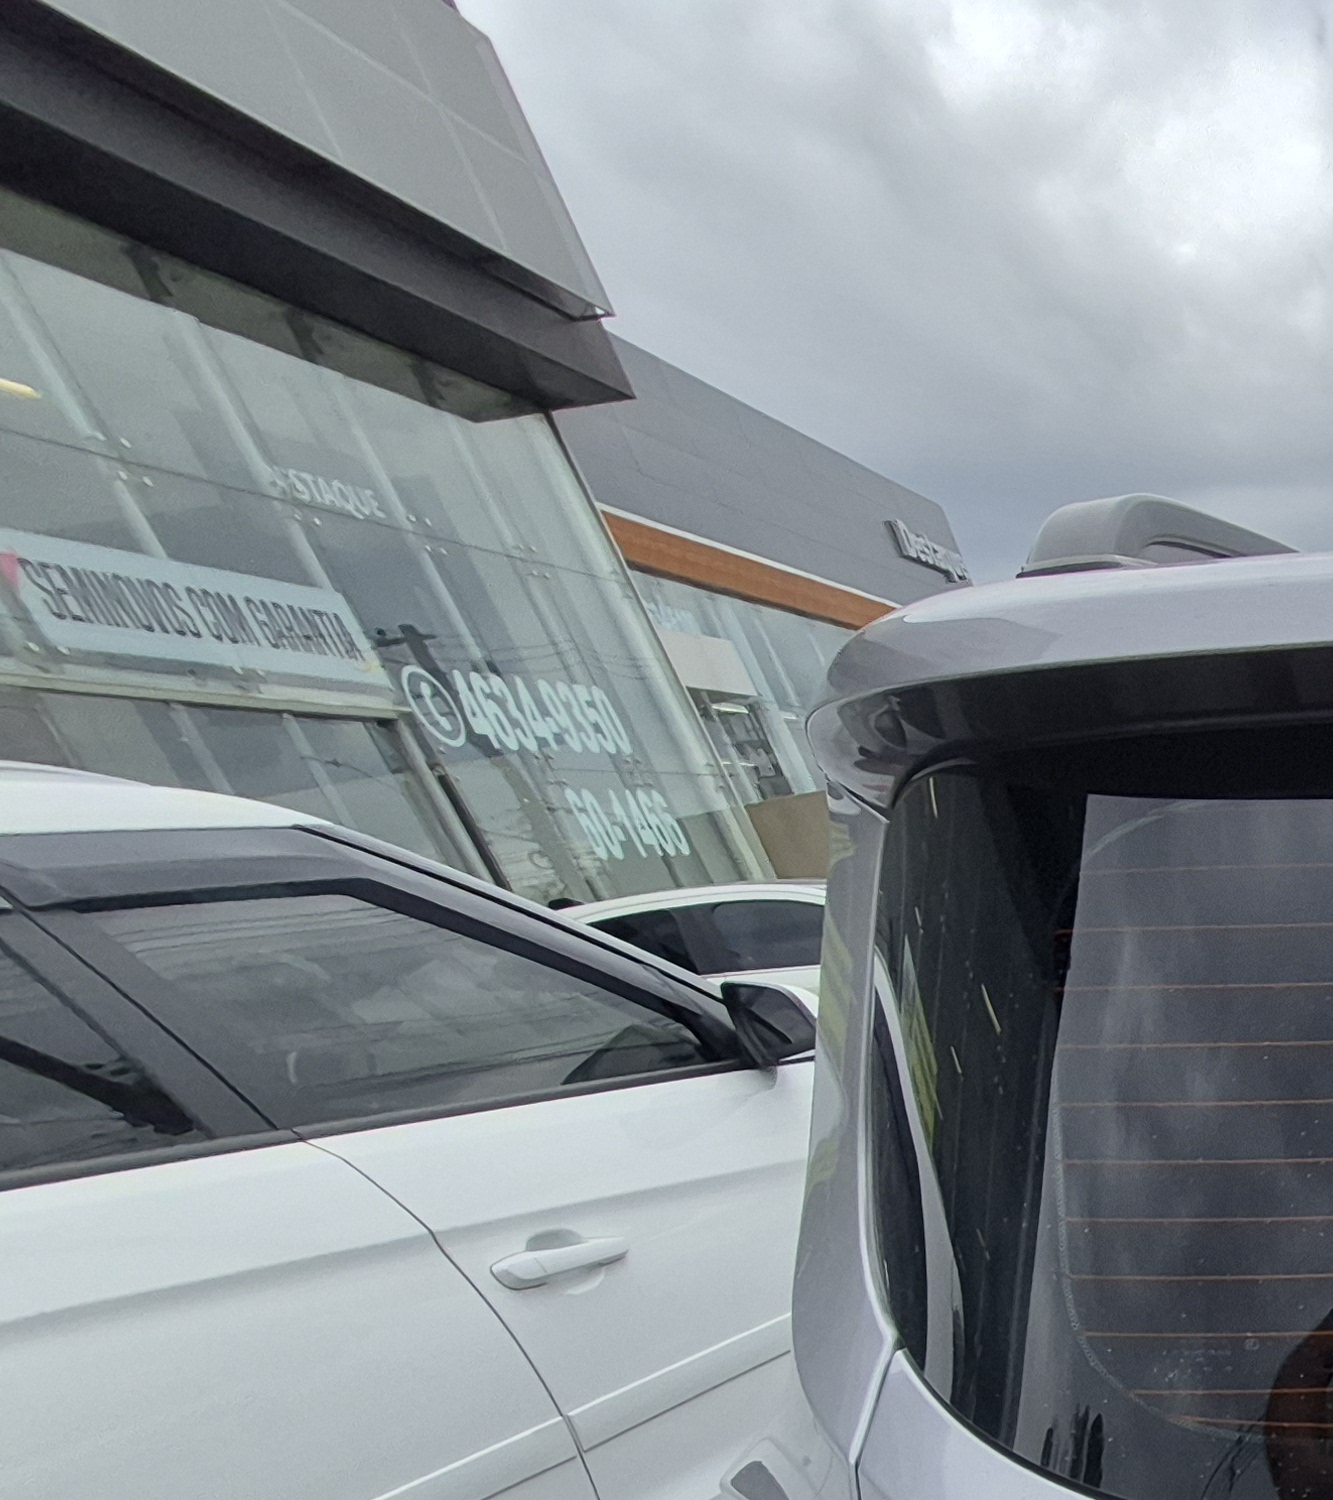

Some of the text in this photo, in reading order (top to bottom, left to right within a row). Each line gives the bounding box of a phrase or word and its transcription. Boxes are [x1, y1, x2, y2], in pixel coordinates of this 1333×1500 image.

[268, 465, 388, 520] STAQUE
[15, 556, 368, 662] SEMINOVOS COM GARANTIA
[452, 669, 635, 755] 4634-9350
